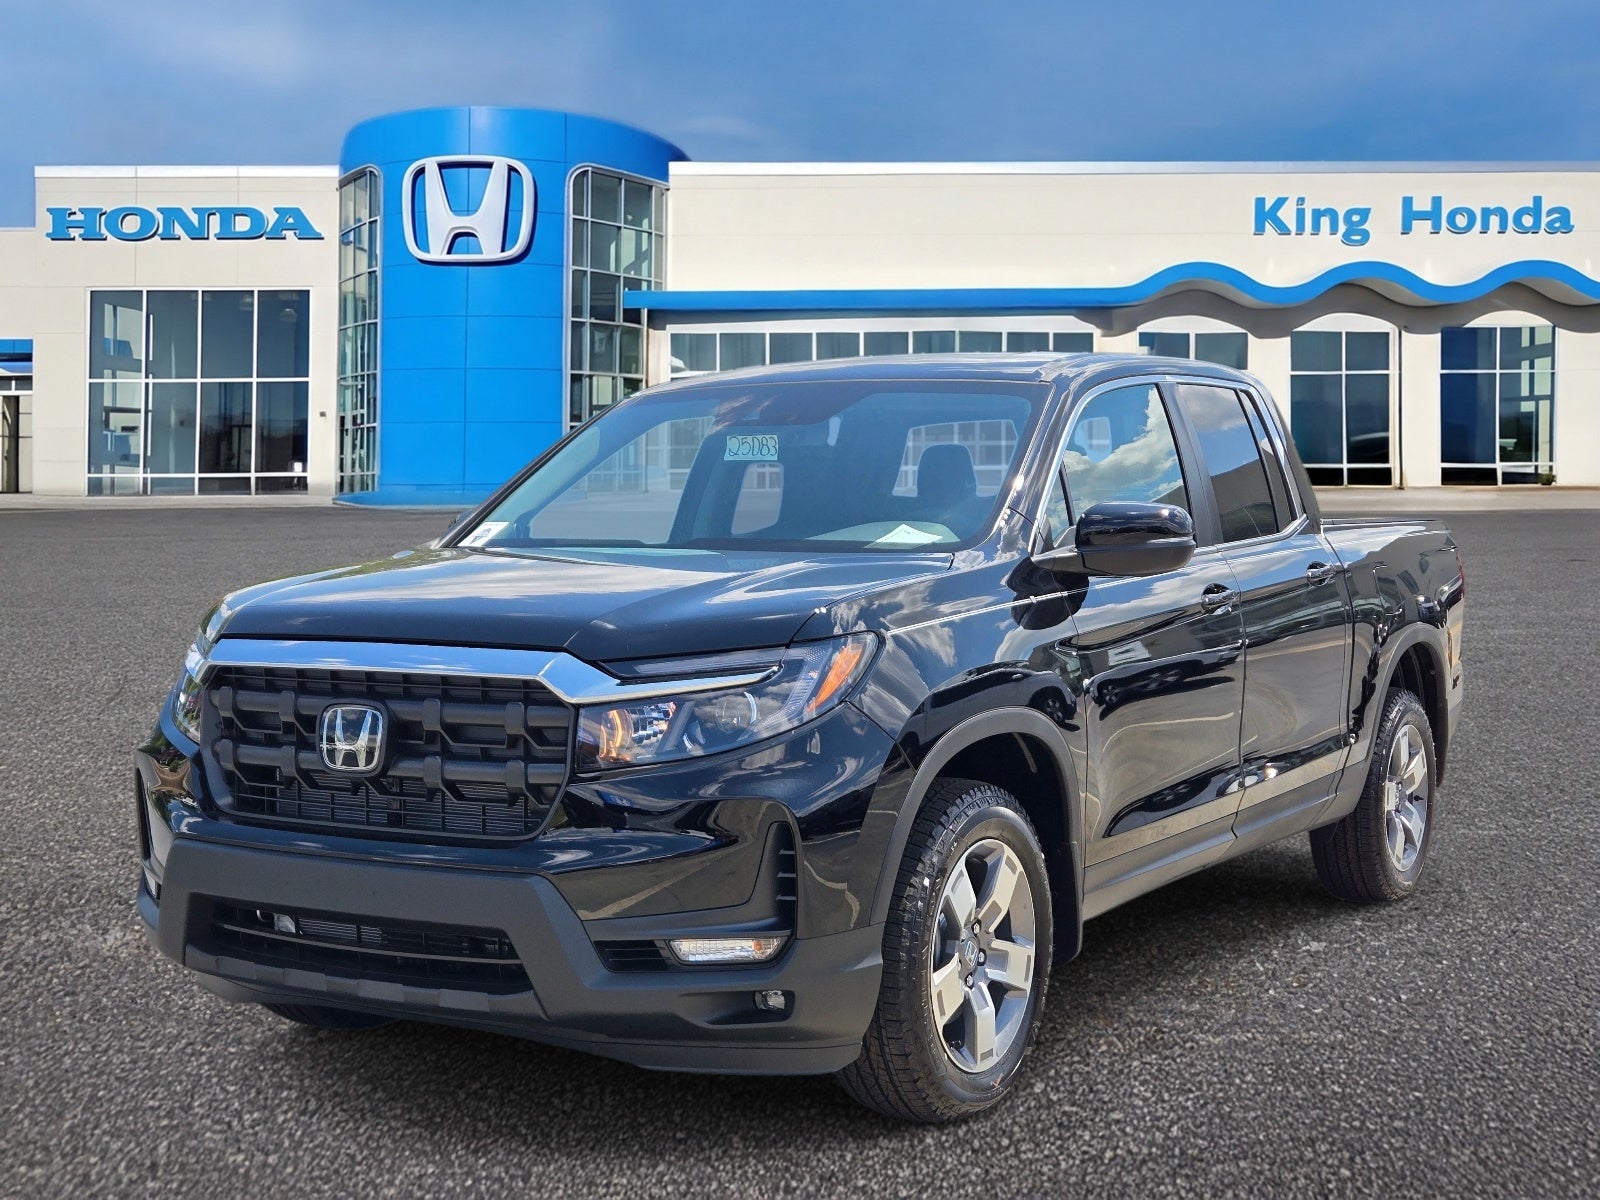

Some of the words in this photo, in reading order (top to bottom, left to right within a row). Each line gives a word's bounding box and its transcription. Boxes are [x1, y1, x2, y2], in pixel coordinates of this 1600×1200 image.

[45, 206, 324, 241] HONDA
[1253, 196, 1372, 246] King
[1400, 195, 1574, 235] Honda
[728, 436, 778, 457] 25D83
